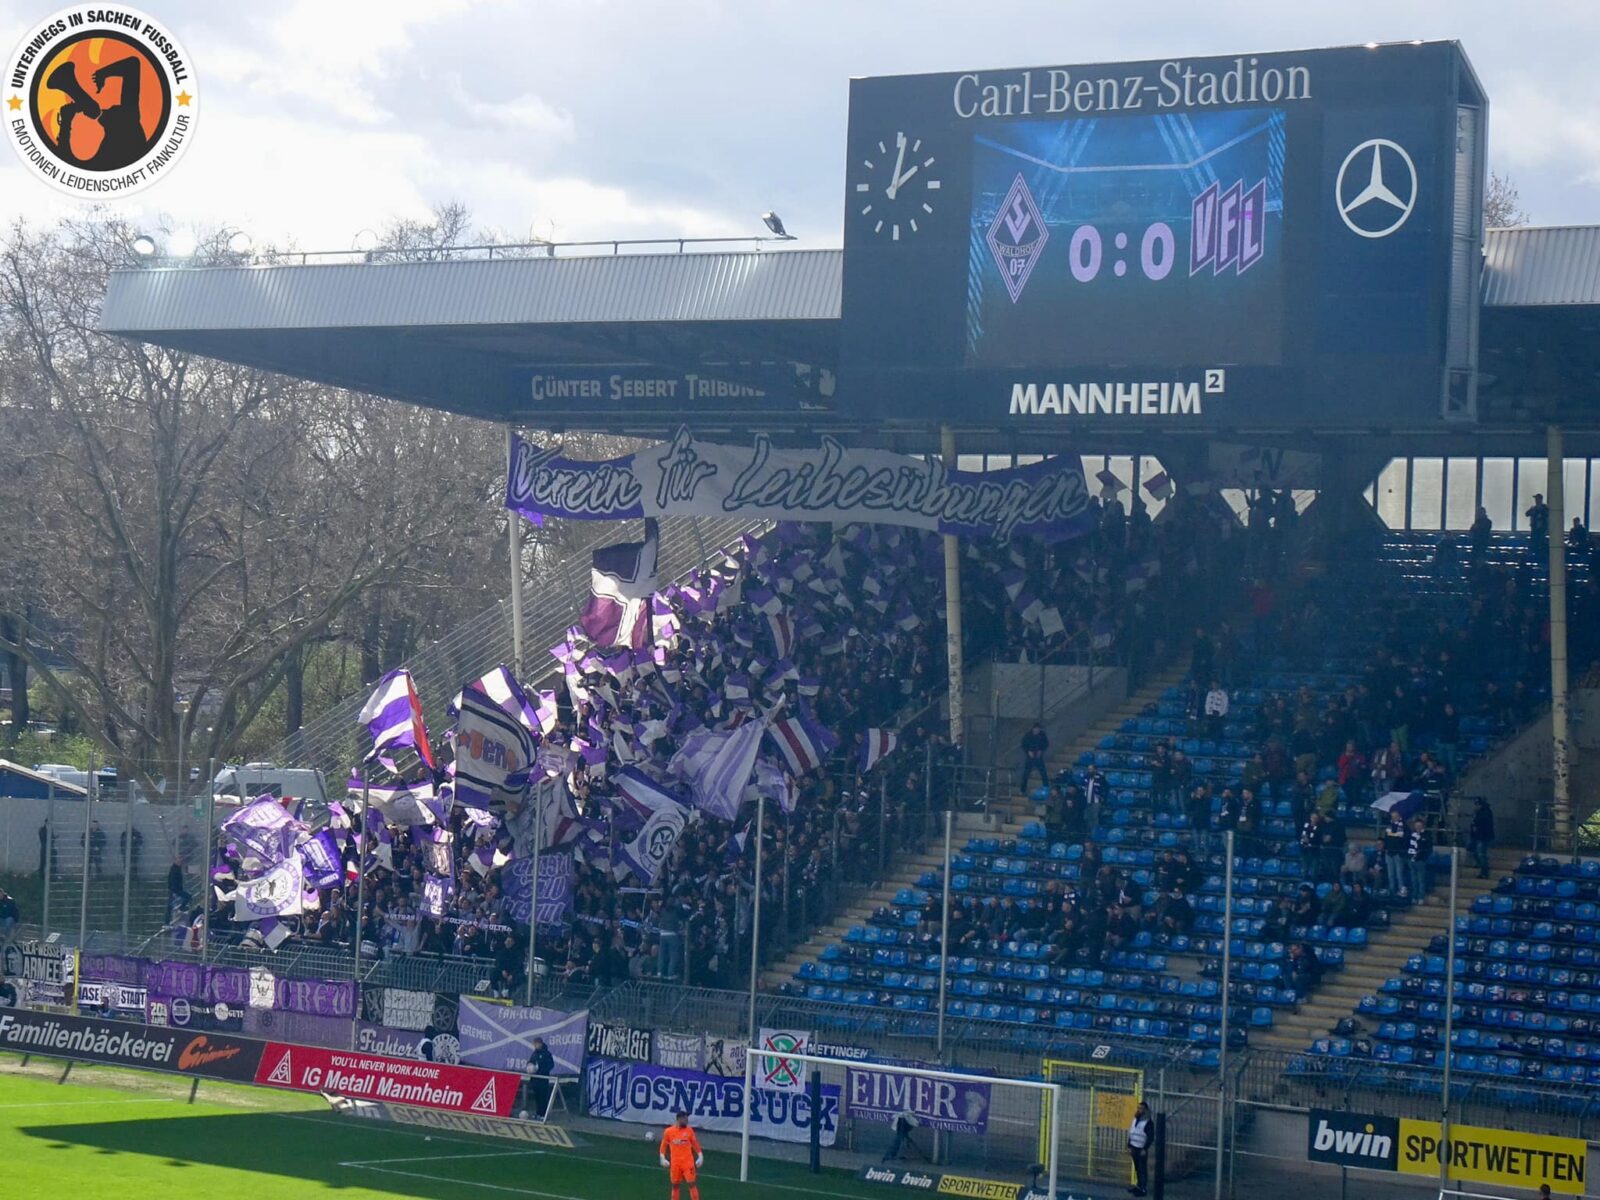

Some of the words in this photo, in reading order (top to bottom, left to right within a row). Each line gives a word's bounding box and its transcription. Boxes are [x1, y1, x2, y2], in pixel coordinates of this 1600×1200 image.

[953, 57, 1312, 118] Carl-Benz-Stadion
[1009, 258, 1026, 276] 07
[531, 374, 602, 400] GÜNTER
[610, 374, 678, 400] SEBERT
[1009, 382, 1202, 415] MANNHEIM
[511, 440, 643, 512] Verein
[656, 423, 717, 509] für
[722, 432, 1090, 548] Leibesübungen
[23, 956, 60, 981] ARMEE
[120, 989, 146, 1006] STADT
[0, 1015, 175, 1062] Familienbäckerei
[807, 1043, 869, 1060] METTINGEN
[358, 1059, 385, 1072] NEVER
[386, 1063, 412, 1076] WORK
[411, 1066, 440, 1079] ALONE
[302, 1066, 322, 1087] IG
[324, 1070, 373, 1094] Metall
[377, 1076, 464, 1107] Mannheim
[850, 1070, 958, 1119] EIMER
[393, 1107, 568, 1145] SPORTWETTEN
[1314, 1120, 1391, 1159] bwin
[1405, 1134, 1585, 1183] SPORTWETTEN
[865, 1168, 895, 1183] bwin
[901, 1172, 932, 1188] bwin
[940, 1177, 1019, 1199] SPORTWETTEN
